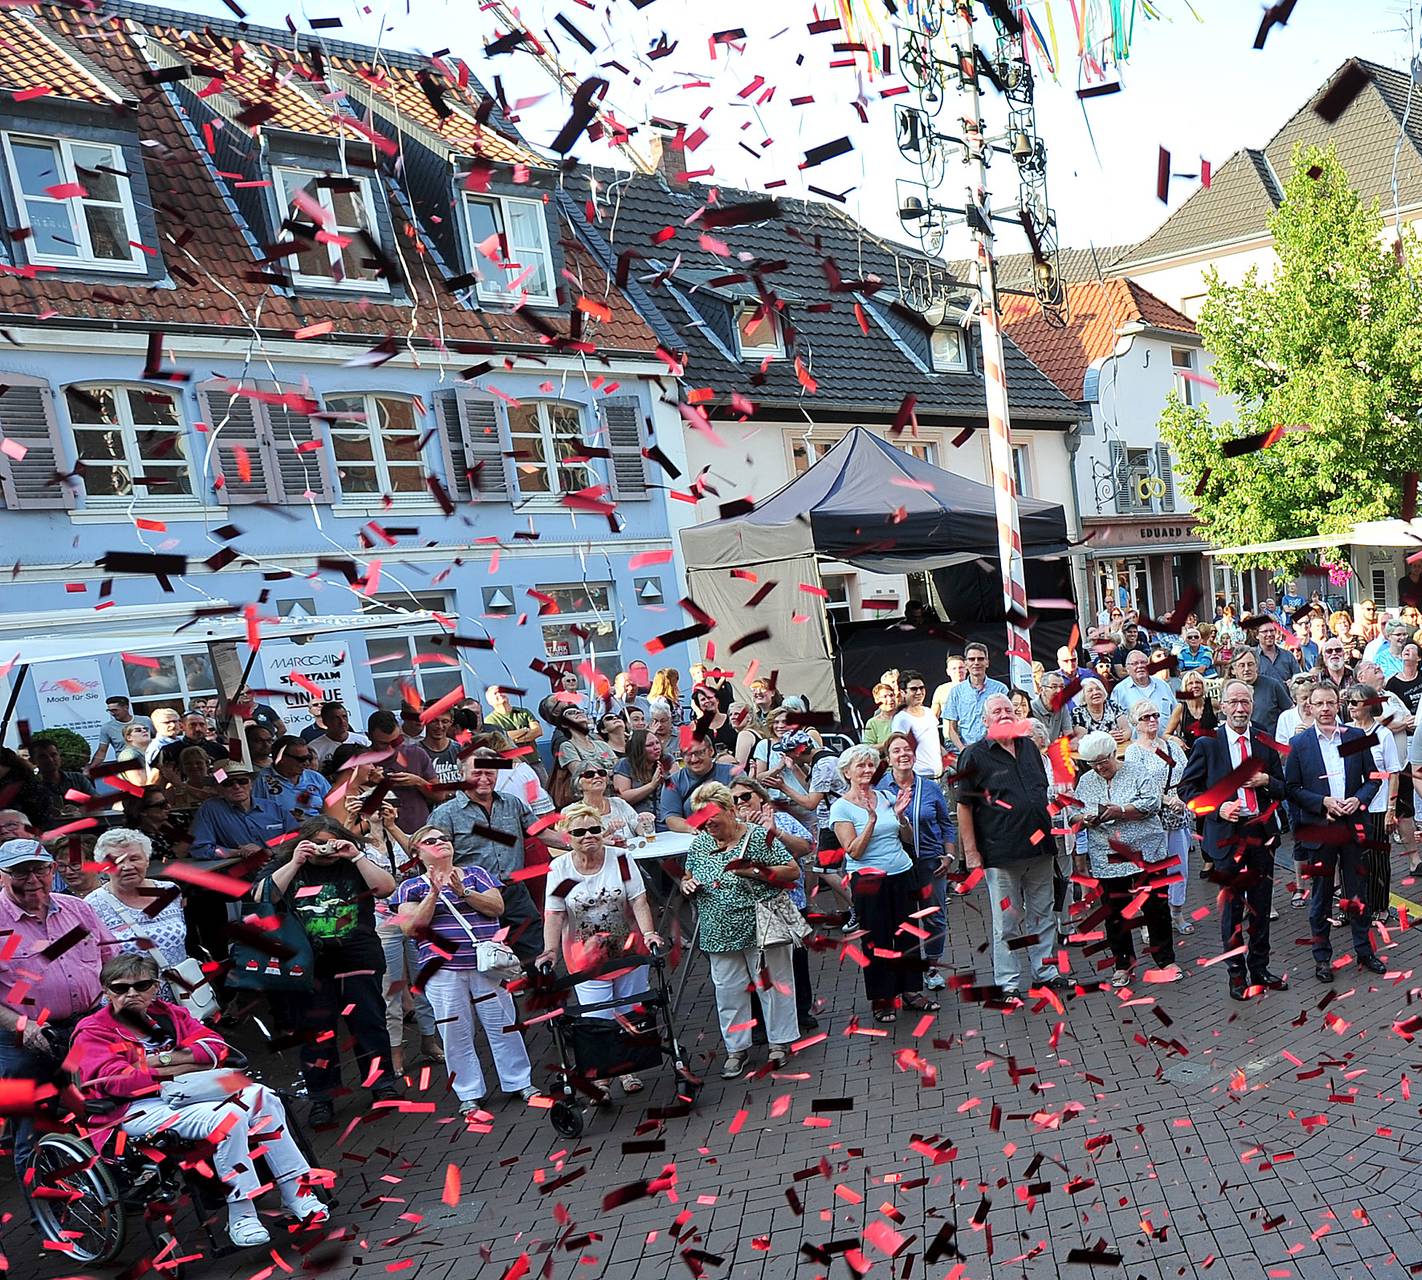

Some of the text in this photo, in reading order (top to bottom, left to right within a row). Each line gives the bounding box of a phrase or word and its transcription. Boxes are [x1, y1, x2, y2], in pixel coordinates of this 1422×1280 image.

[1140, 527, 1182, 538] EDUARD
[85, 692, 99, 700] Sie
[284, 688, 343, 705] CINUE
